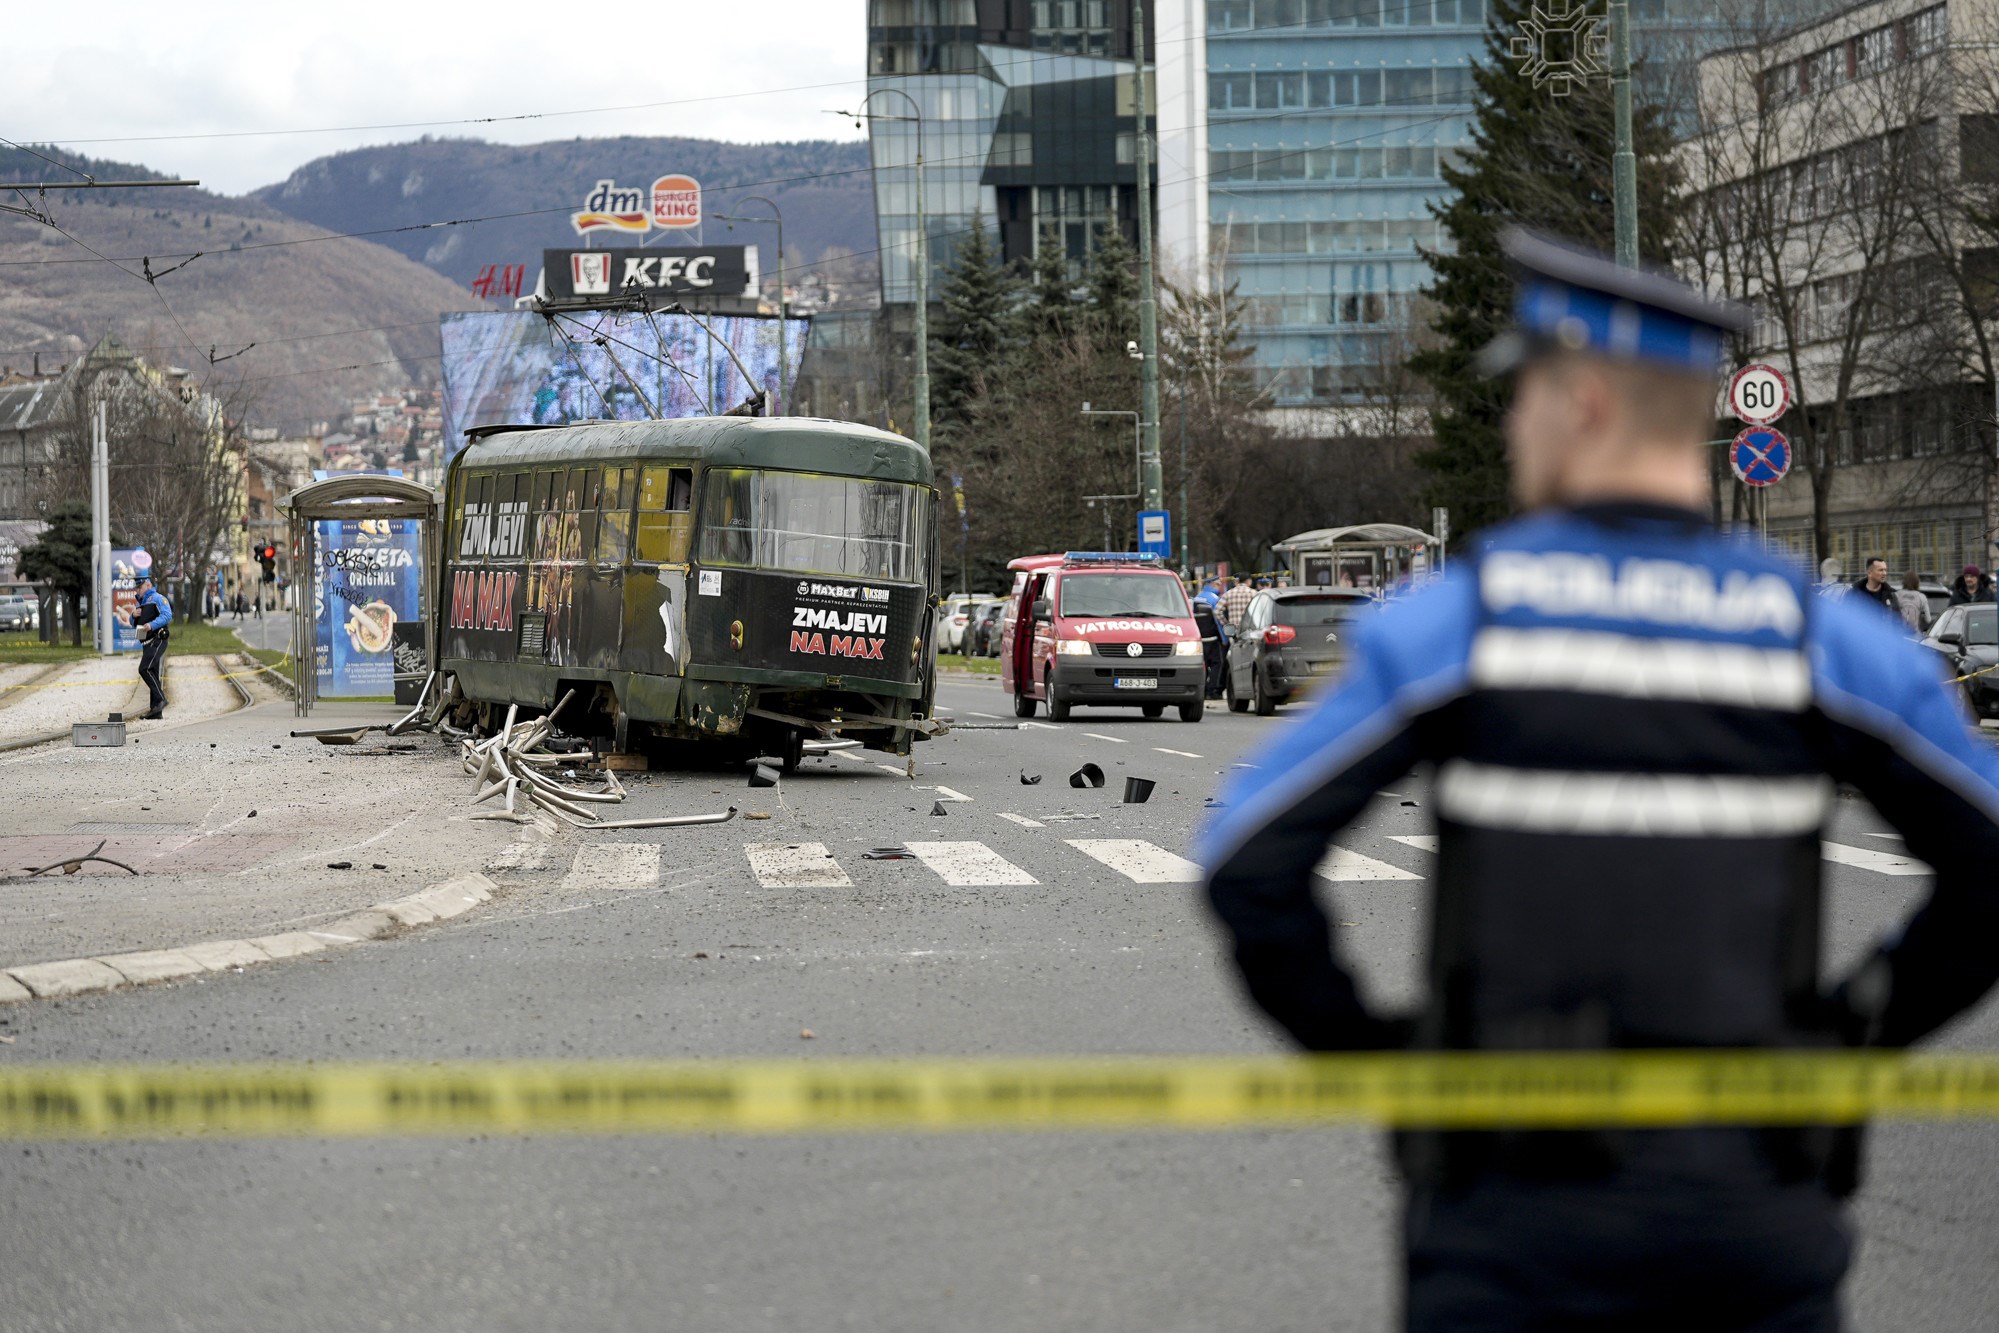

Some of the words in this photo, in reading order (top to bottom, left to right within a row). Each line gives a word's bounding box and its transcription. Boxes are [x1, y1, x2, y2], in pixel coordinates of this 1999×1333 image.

[590, 184, 638, 212] dm
[655, 192, 698, 201] BURGER
[655, 204, 697, 216] KING
[472, 263, 525, 299] H&M
[620, 256, 716, 288] KFC
[1742, 380, 1775, 409] 60
[460, 502, 528, 557] ZMAJEVI
[349, 571, 396, 586] ORIGINAL
[450, 570, 475, 629] NA
[476, 570, 518, 632] MAX
[846, 602, 889, 610] REPREZENTACIJE
[792, 606, 888, 635] ZMAJEVI
[1074, 620, 1184, 637] VATROGASCI
[789, 630, 826, 655] NA
[829, 634, 886, 660] MAX
[1119, 678, 1158, 688] A68-J-403
